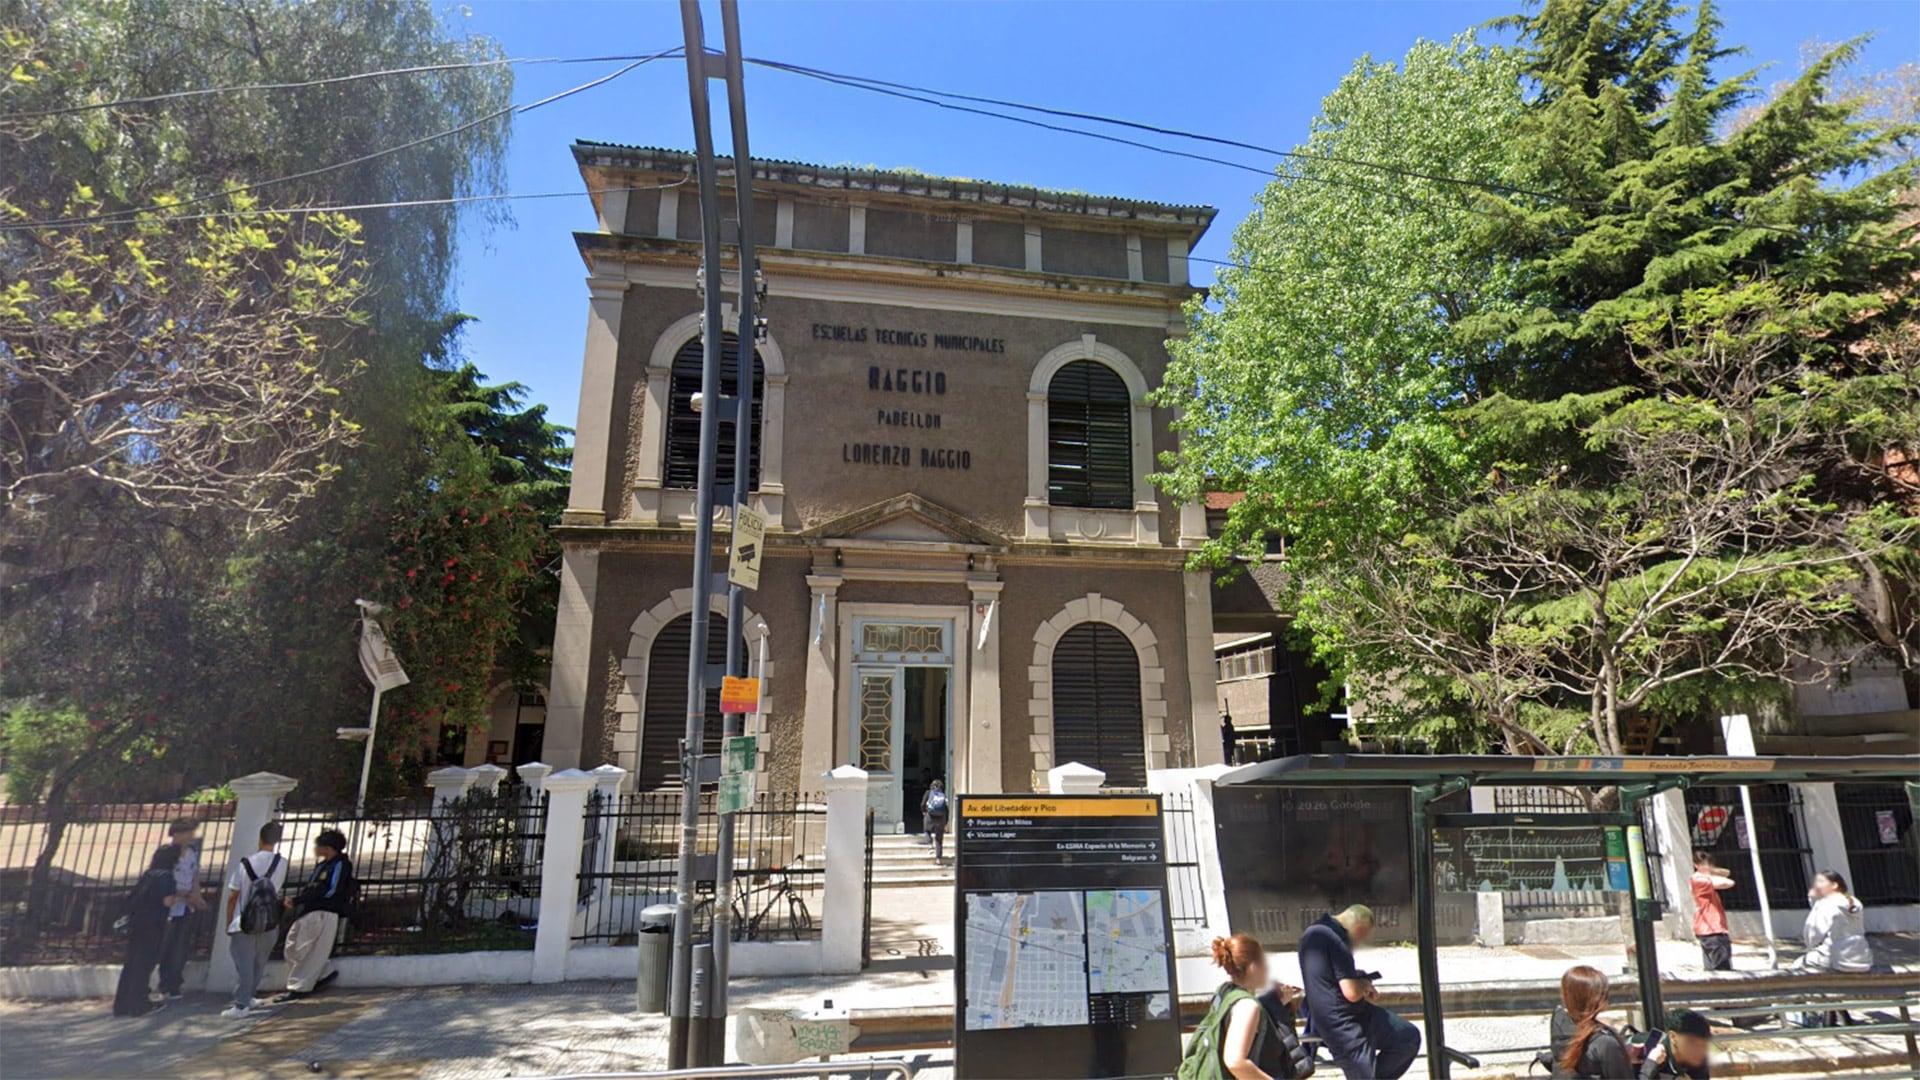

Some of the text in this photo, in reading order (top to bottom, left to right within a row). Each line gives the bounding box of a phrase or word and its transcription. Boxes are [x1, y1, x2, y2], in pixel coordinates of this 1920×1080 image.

[812, 323, 1005, 354] ESCUELAS TECNICAS MUNICIPALES
[868, 366, 947, 396] RAGGIO
[877, 410, 942, 430] PABELLON
[842, 442, 972, 470] LORENZO RAGGIO
[967, 804, 978, 812] Av.
[981, 804, 993, 812] del
[1041, 804, 1057, 812] Pico
[976, 831, 999, 839] Vicente
